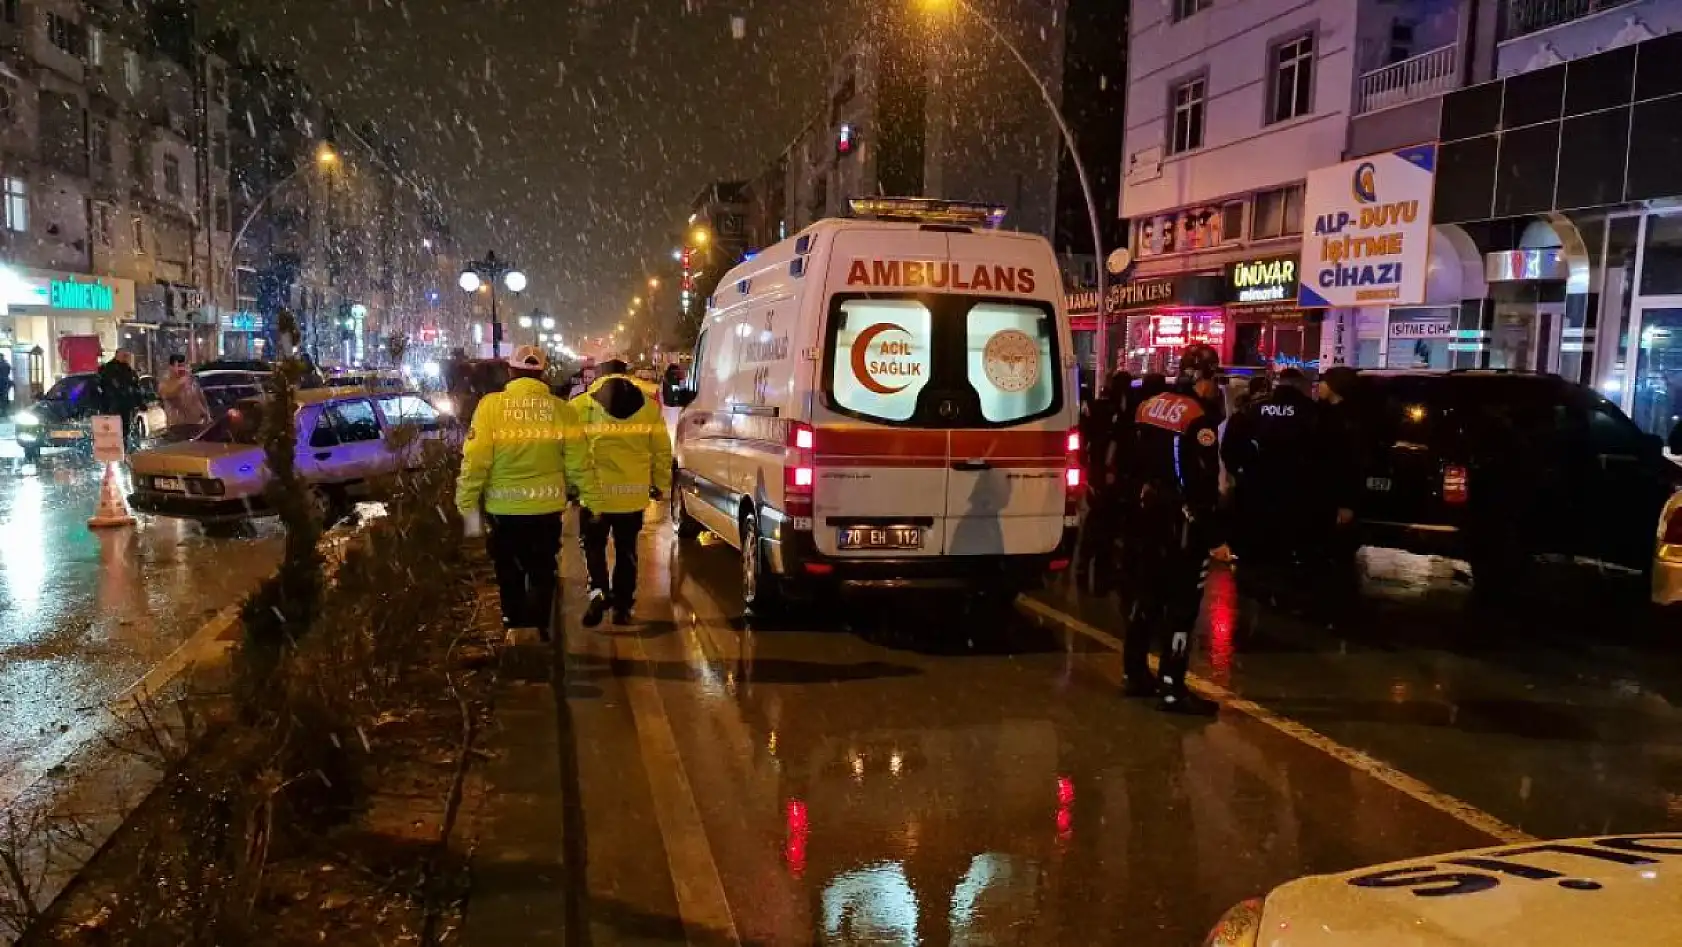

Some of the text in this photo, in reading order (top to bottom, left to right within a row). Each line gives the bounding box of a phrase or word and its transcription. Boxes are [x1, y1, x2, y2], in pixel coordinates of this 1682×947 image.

[1359, 199, 1419, 230] DUYU
[1319, 231, 1404, 265] İŞİTME
[848, 260, 1036, 294] AMBULANS
[1234, 259, 1295, 287] ÜNÜVAR
[1318, 261, 1404, 288] CİHAZI
[879, 338, 912, 356] ACİL
[869, 358, 921, 376] SAĞLIK
[847, 529, 918, 545] 70 EH 112
